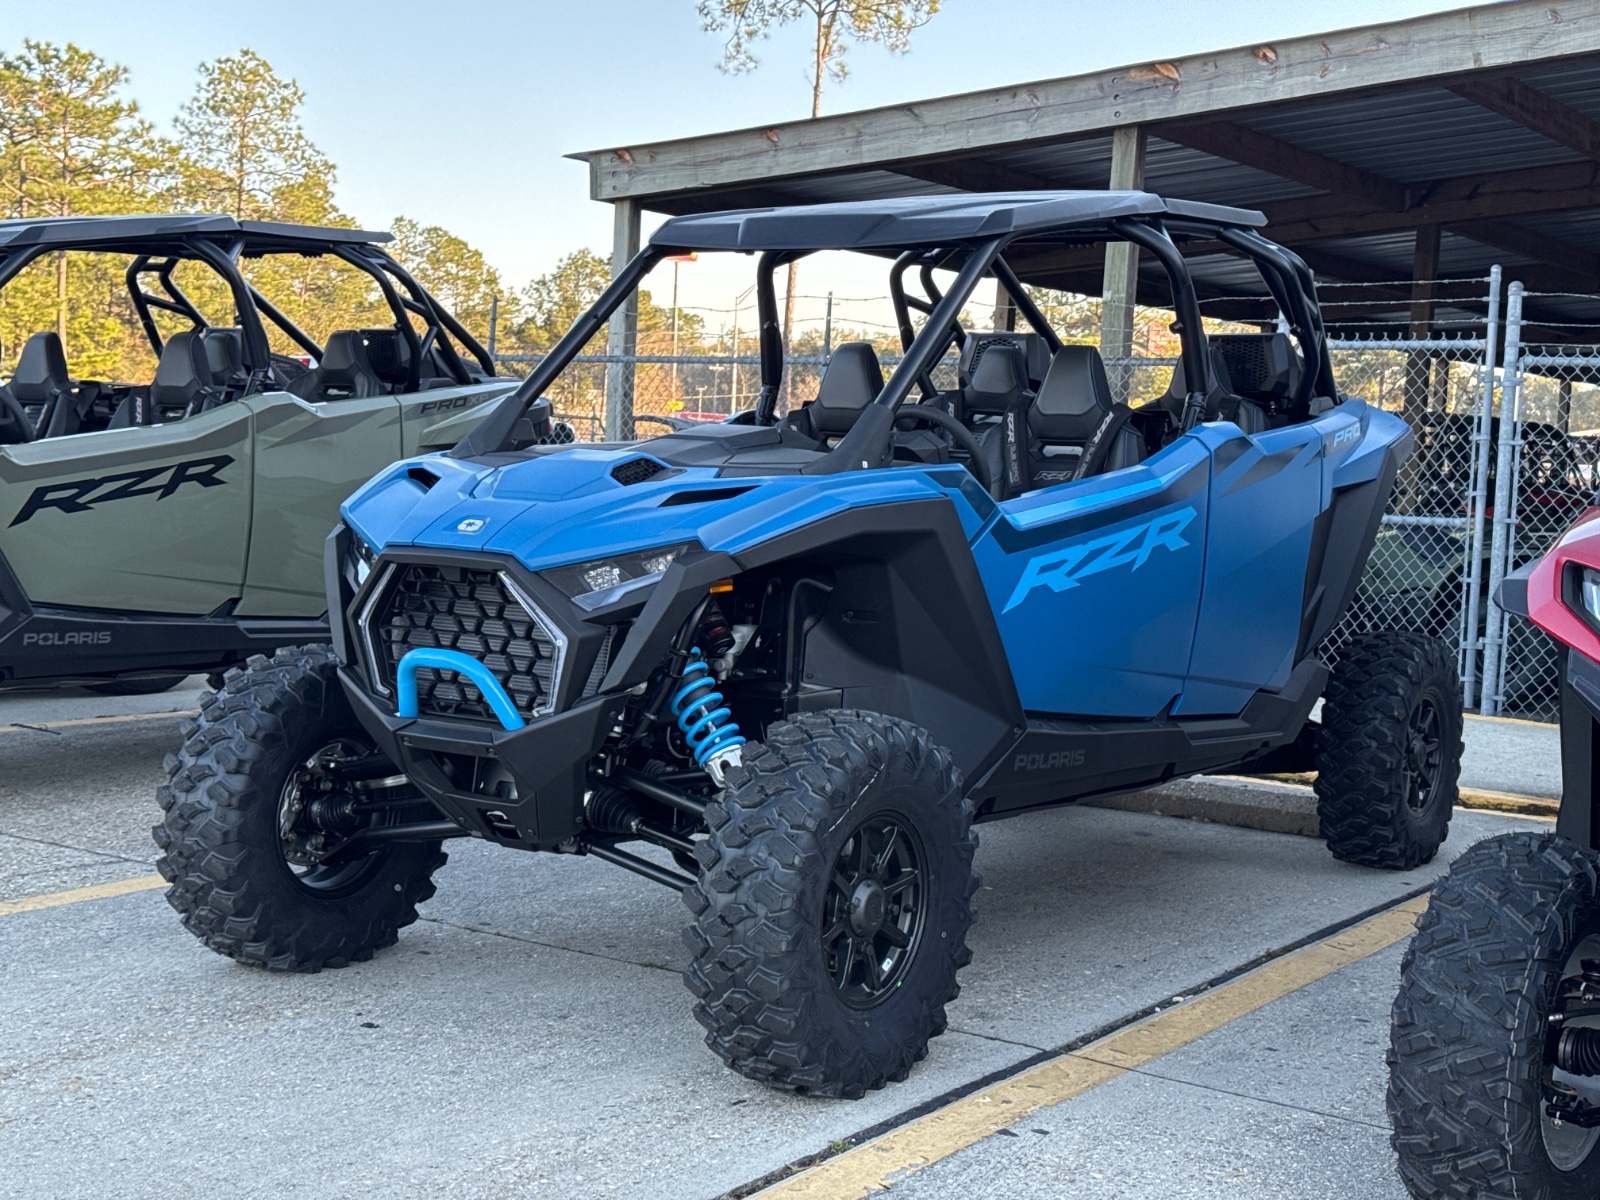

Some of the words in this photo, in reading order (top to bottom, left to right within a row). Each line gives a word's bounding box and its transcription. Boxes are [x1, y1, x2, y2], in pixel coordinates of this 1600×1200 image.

[420, 397, 467, 414] PRO
[468, 393, 489, 406] XP
[1007, 412, 1015, 443] RZR
[1092, 411, 1114, 444] RZR
[1333, 423, 1361, 447] PRO
[7, 454, 236, 529] RZR
[1001, 506, 1197, 615] RZR
[22, 631, 112, 646] POLARIS
[1014, 750, 1086, 772] POLARIS
